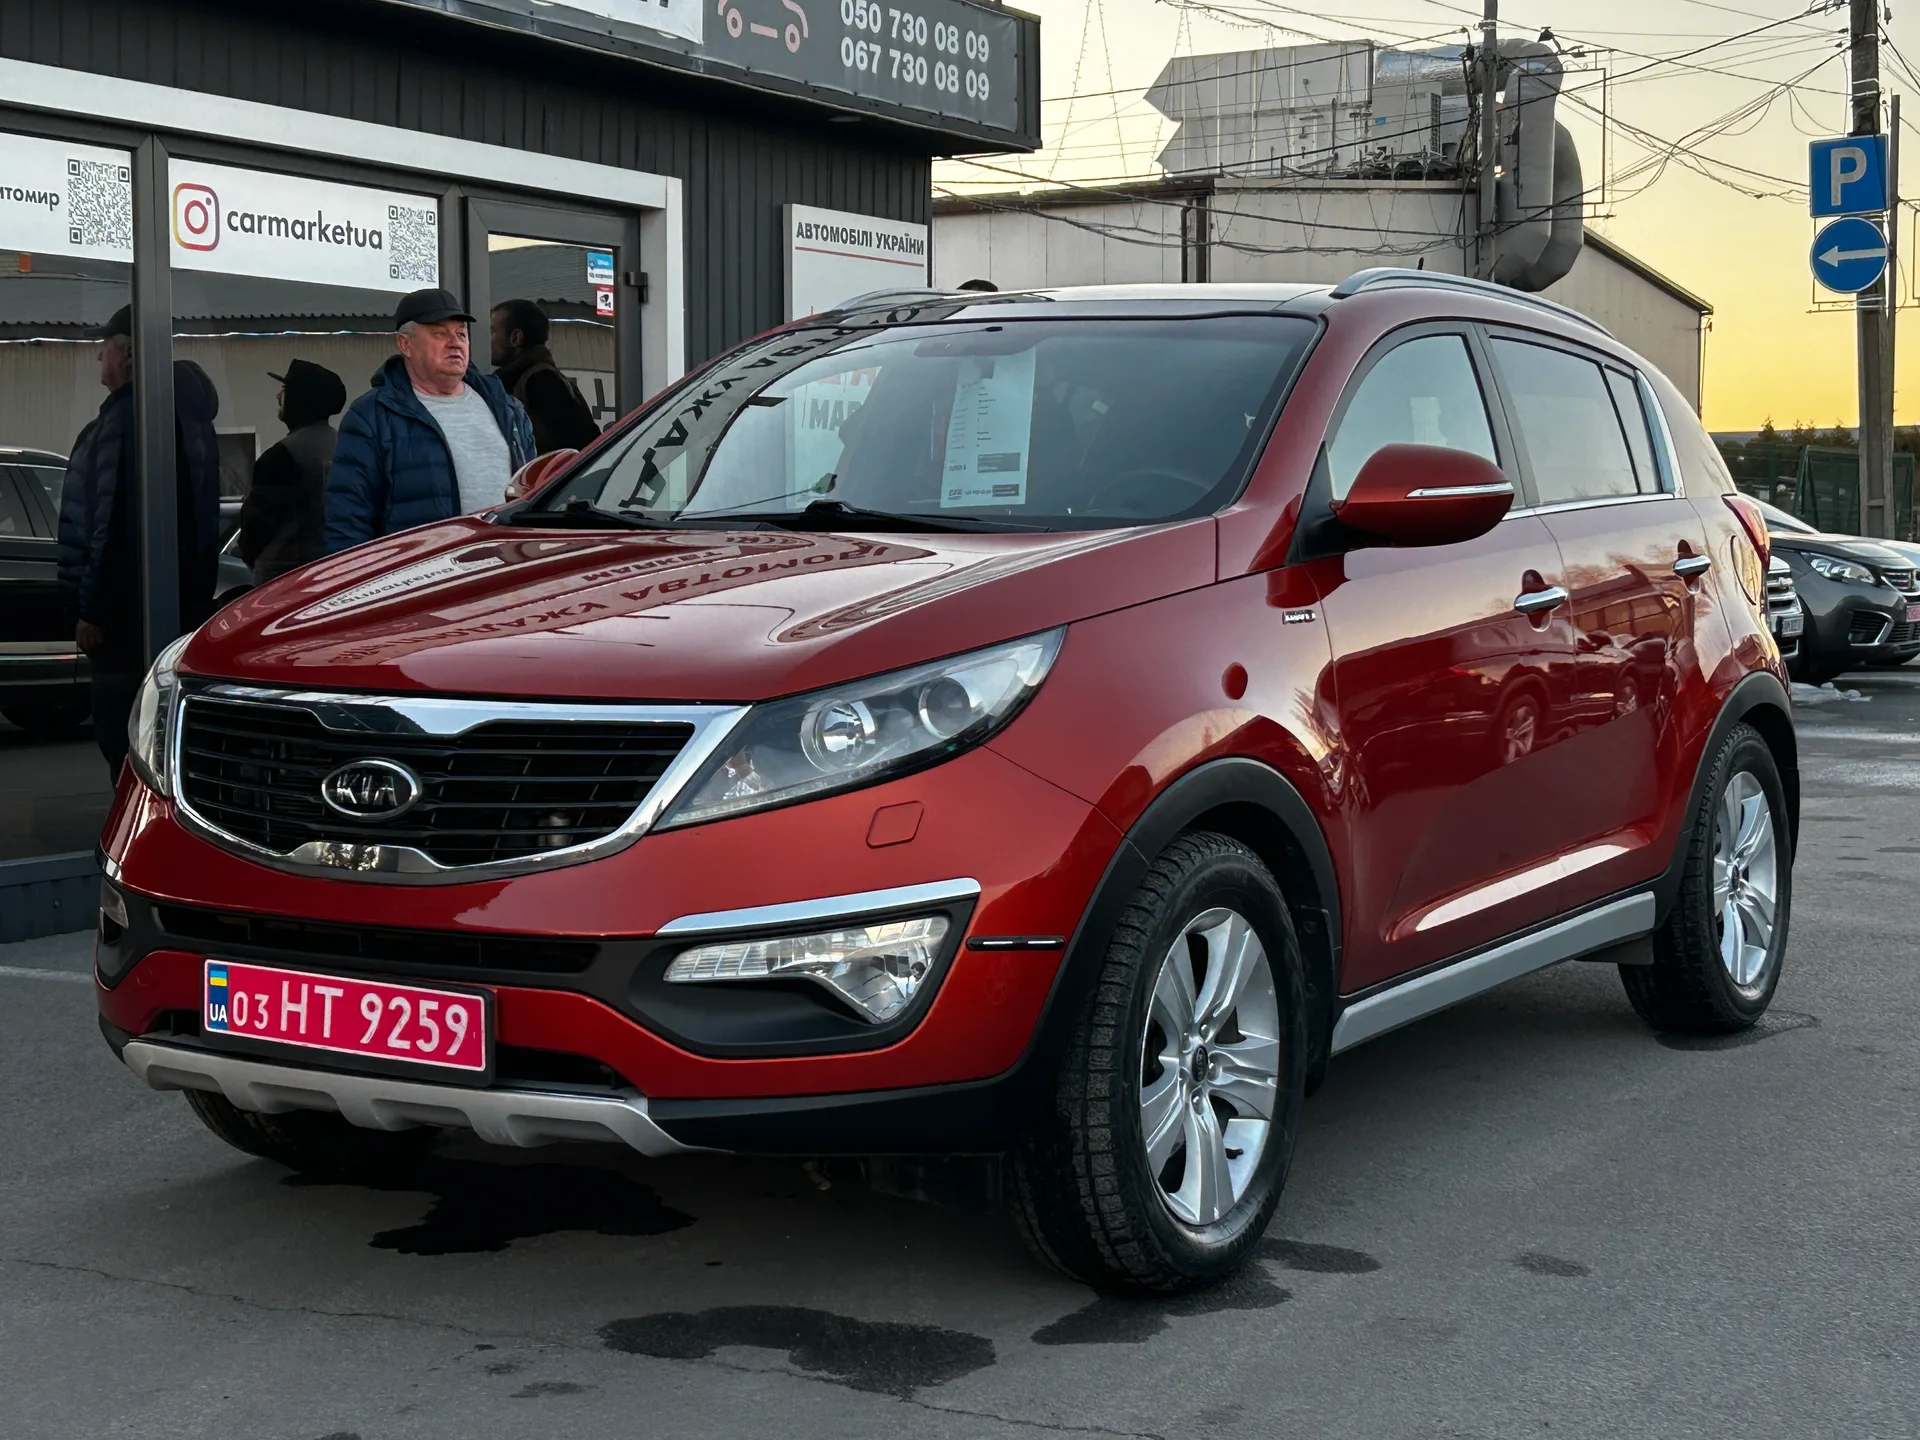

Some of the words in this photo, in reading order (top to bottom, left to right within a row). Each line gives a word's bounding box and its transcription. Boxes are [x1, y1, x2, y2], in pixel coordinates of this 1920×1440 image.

[841, 0, 882, 33] 050
[889, 8, 928, 46] 730
[934, 21, 959, 54] 08
[965, 30, 990, 62] 09
[841, 36, 882, 74] 067
[889, 48, 928, 85] 730
[934, 61, 959, 93] 08
[965, 69, 990, 101] 09
[1830, 146, 1867, 207] P
[226, 209, 383, 250] carmarketua
[796, 221, 873, 248] АВТОМОБІЛІ
[875, 231, 924, 256] УКРАЇНИ
[809, 398, 864, 431] МА
[209, 1002, 228, 1024] UA
[232, 990, 270, 1030] 03
[279, 980, 344, 1039] HT
[360, 992, 469, 1056] 9259
